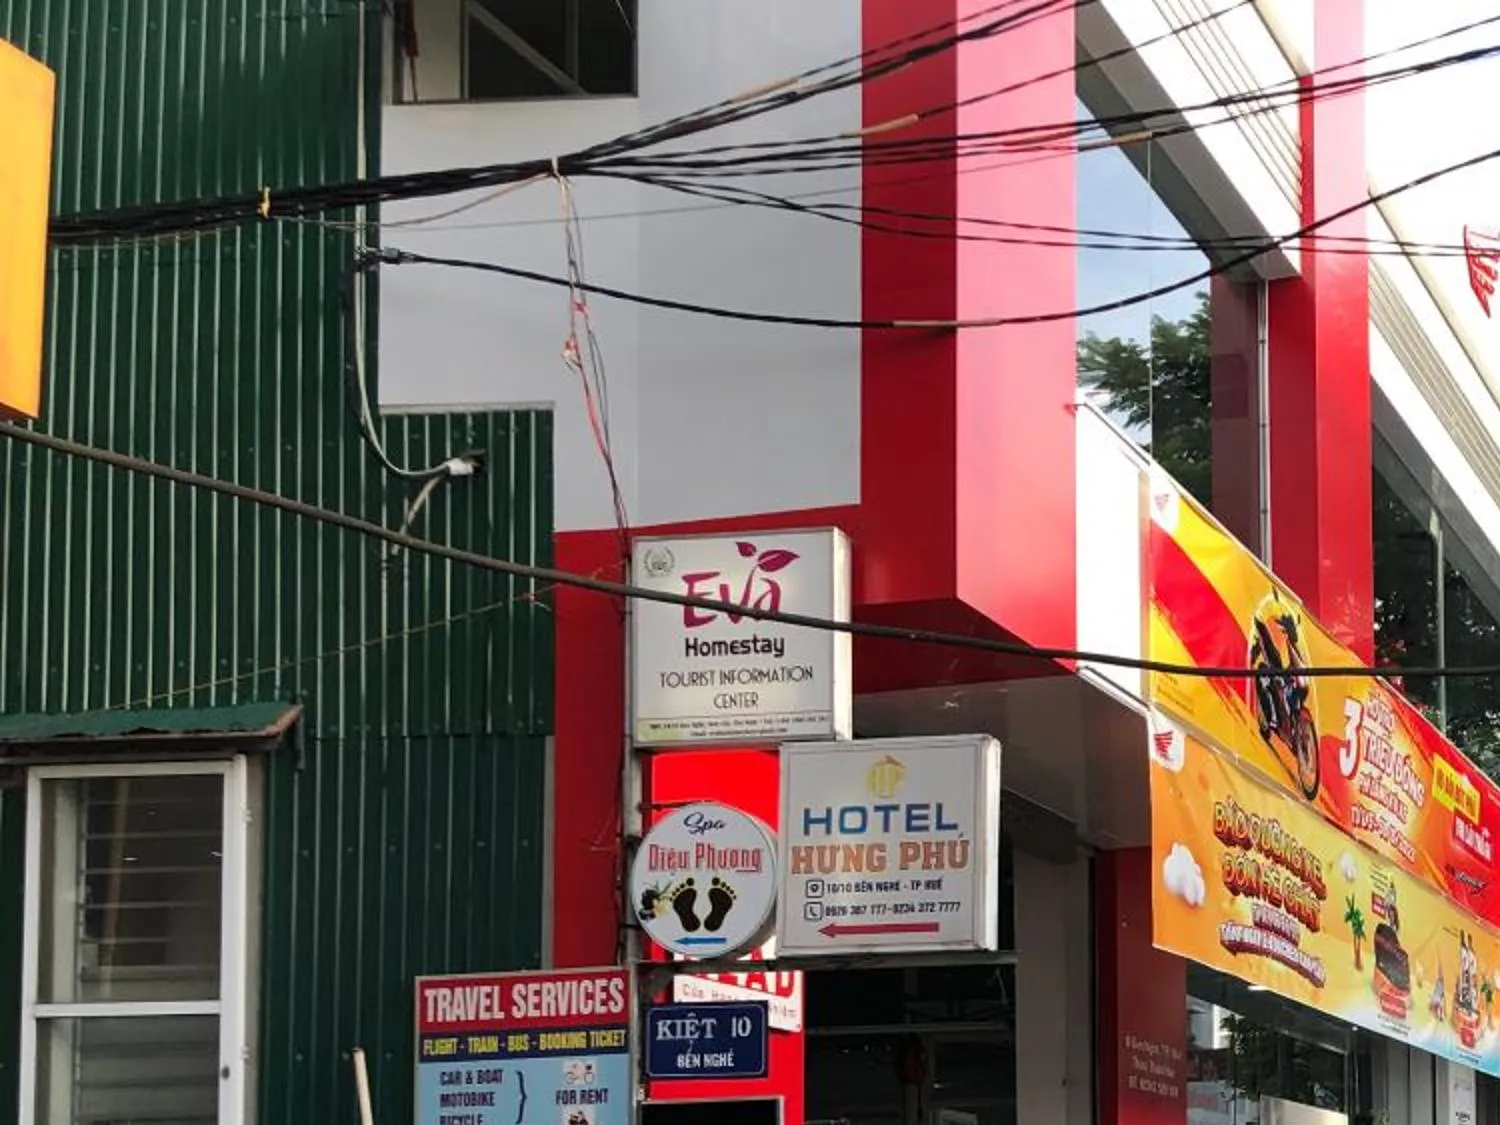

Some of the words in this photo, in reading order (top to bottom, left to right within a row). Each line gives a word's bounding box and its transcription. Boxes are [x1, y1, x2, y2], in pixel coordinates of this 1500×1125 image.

[685, 634, 785, 659] Homestay
[660, 668, 716, 689] TOURIST
[719, 665, 814, 686] INFORMATION
[713, 692, 759, 709] CENTER
[684, 812, 725, 835] Spa
[803, 803, 958, 837] HOTEL
[791, 842, 887, 875] HƯNG
[899, 833, 970, 871] PHÚ
[424, 985, 504, 1022] TRAVEL
[512, 978, 624, 1018] SERVICES
[656, 1012, 717, 1044] KIỆT
[731, 1016, 752, 1038] 10
[423, 1038, 459, 1055] FLIGHT
[468, 1035, 498, 1054] TRAIN
[508, 1033, 529, 1052] BUS
[539, 1031, 586, 1050] BOOKING
[590, 1030, 626, 1047] TICKET
[677, 1042, 700, 1068] BẾN
[704, 1049, 734, 1067] NGHÉ
[440, 1071, 462, 1085] CAR
[476, 1069, 503, 1084] BOAT
[440, 1091, 495, 1107] MOTOBIKE
[556, 1089, 577, 1105] FOR
[580, 1088, 608, 1104] RENT
